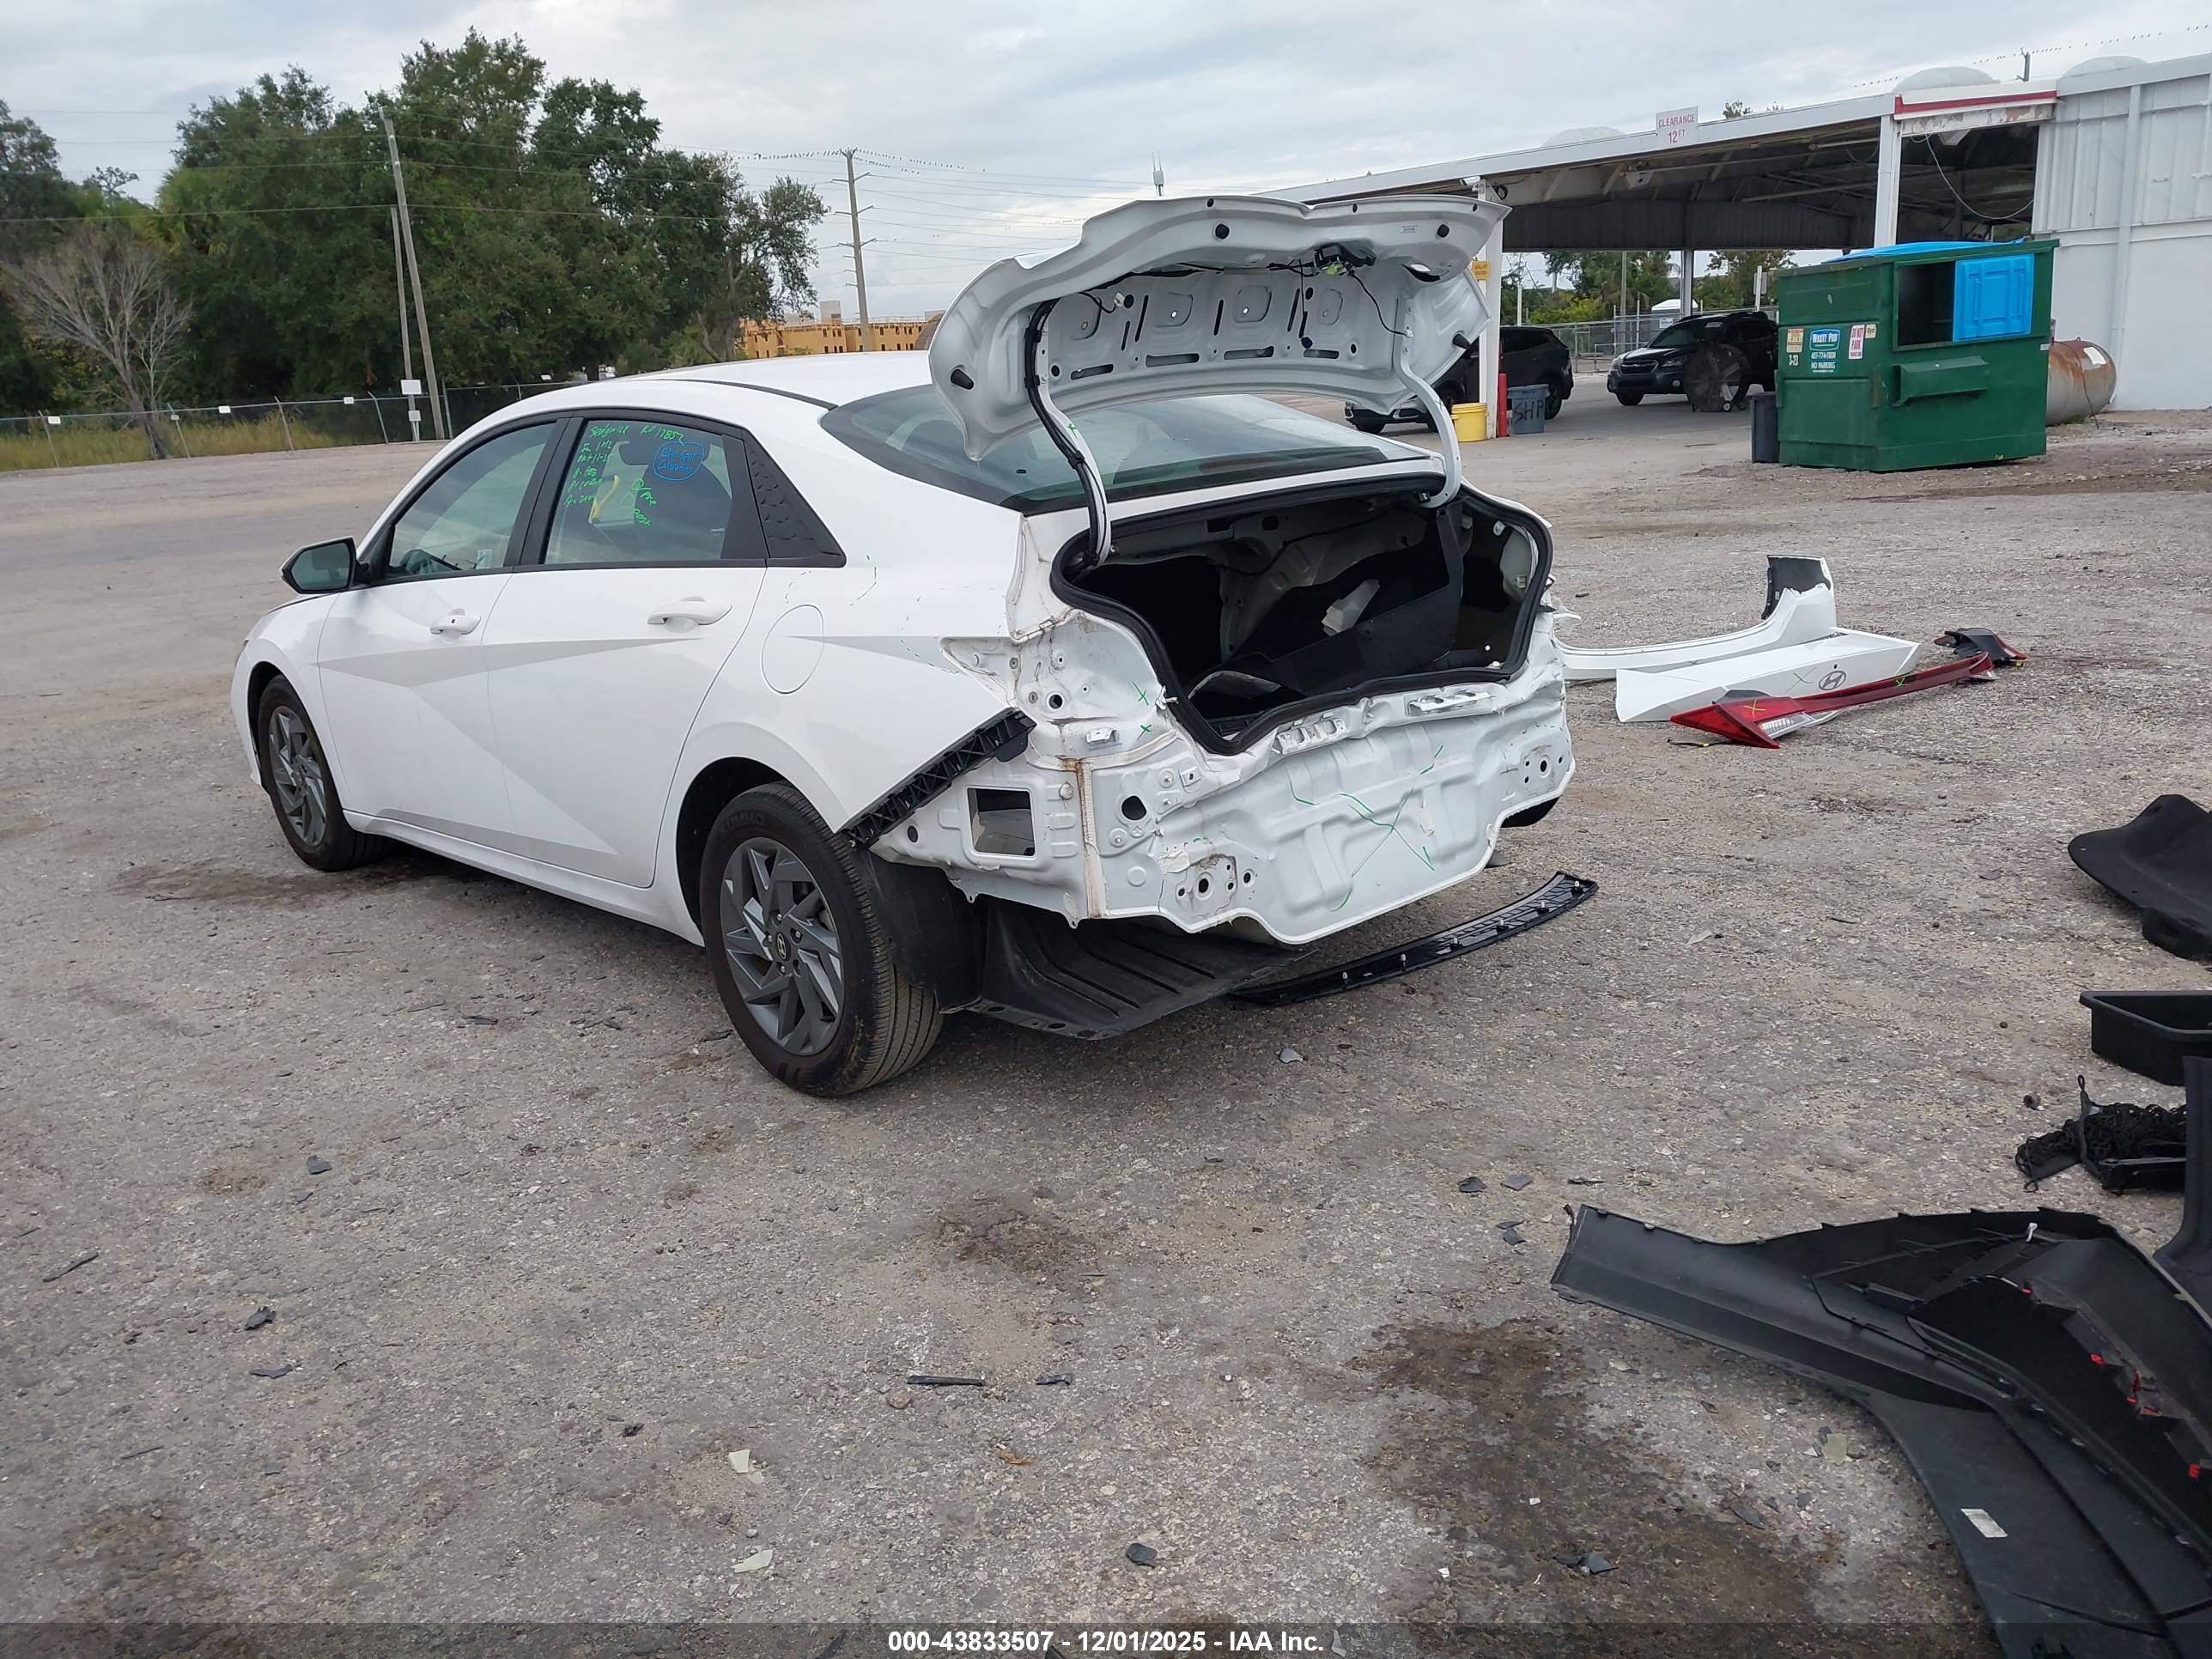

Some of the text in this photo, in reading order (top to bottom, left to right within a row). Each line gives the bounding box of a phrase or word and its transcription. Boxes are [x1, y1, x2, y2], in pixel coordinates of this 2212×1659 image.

[1658, 113, 1695, 128] CLEARANCE
[1668, 131, 1678, 144] 12
[1512, 399, 1545, 425] SHP
